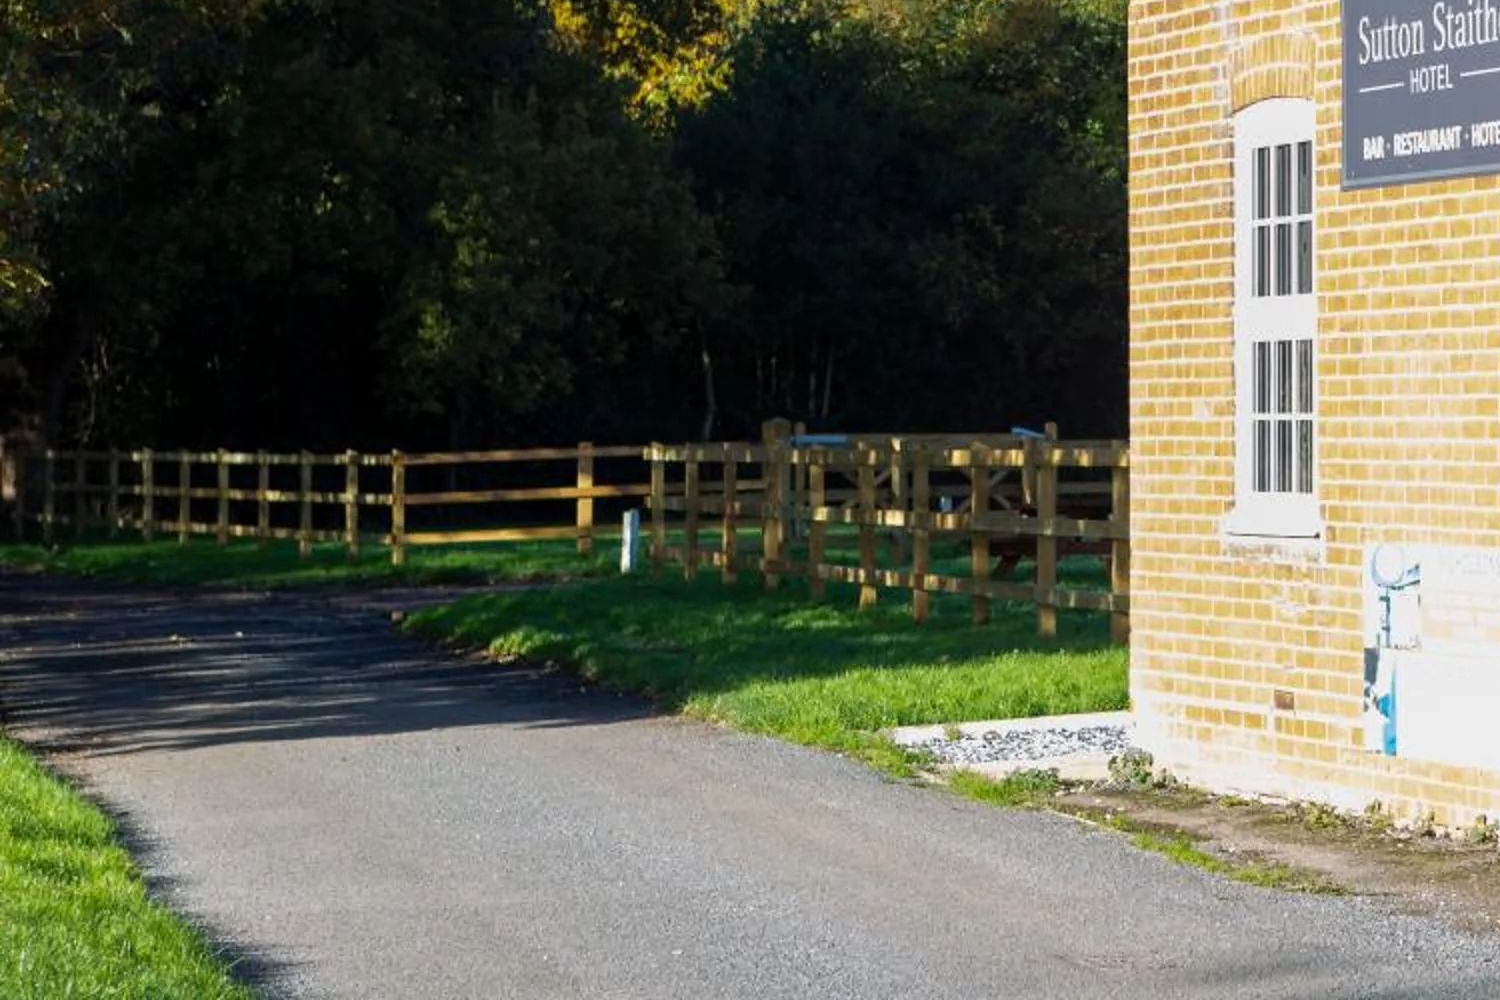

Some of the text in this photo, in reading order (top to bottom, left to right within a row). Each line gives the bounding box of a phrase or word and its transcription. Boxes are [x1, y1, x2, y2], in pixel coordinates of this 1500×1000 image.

[1359, 15, 1425, 65] Sutton
[1409, 63, 1454, 94] HOTEL
[1363, 135, 1385, 161] BAR
[1393, 125, 1463, 157] RESTAURANT
